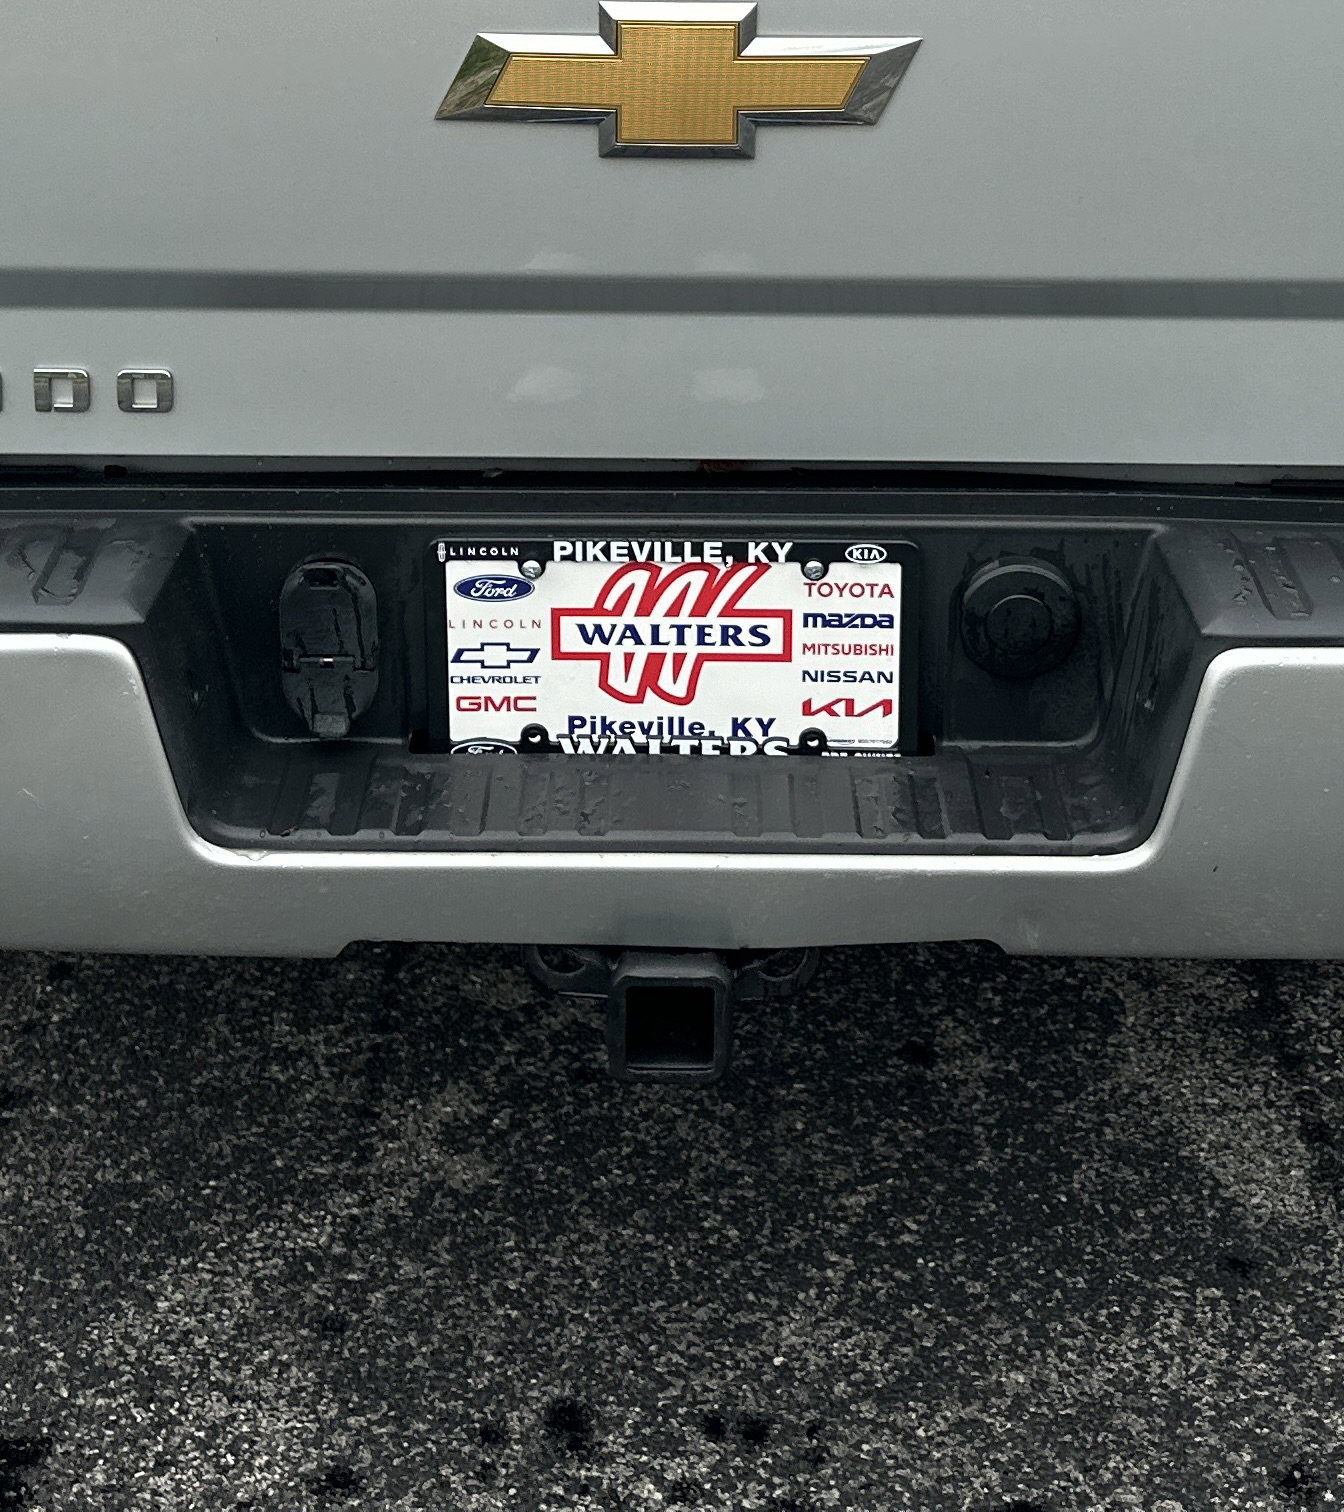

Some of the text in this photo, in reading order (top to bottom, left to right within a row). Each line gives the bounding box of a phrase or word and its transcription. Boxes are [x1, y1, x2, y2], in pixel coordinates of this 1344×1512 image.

[450, 546, 519, 556] LINCOLN
[553, 541, 793, 568] PIKEVILLE, KY
[852, 548, 880, 560] KIA
[470, 579, 518, 598] Ford
[803, 582, 894, 598] TOYOTA
[449, 619, 542, 629] LINCOLN
[576, 623, 771, 647] WALTERS
[802, 643, 894, 656] MITSUBISHI
[450, 675, 541, 685] CHEVROLET
[802, 670, 893, 684] NISSAN
[456, 696, 537, 712] GMC
[731, 717, 777, 738] KY
